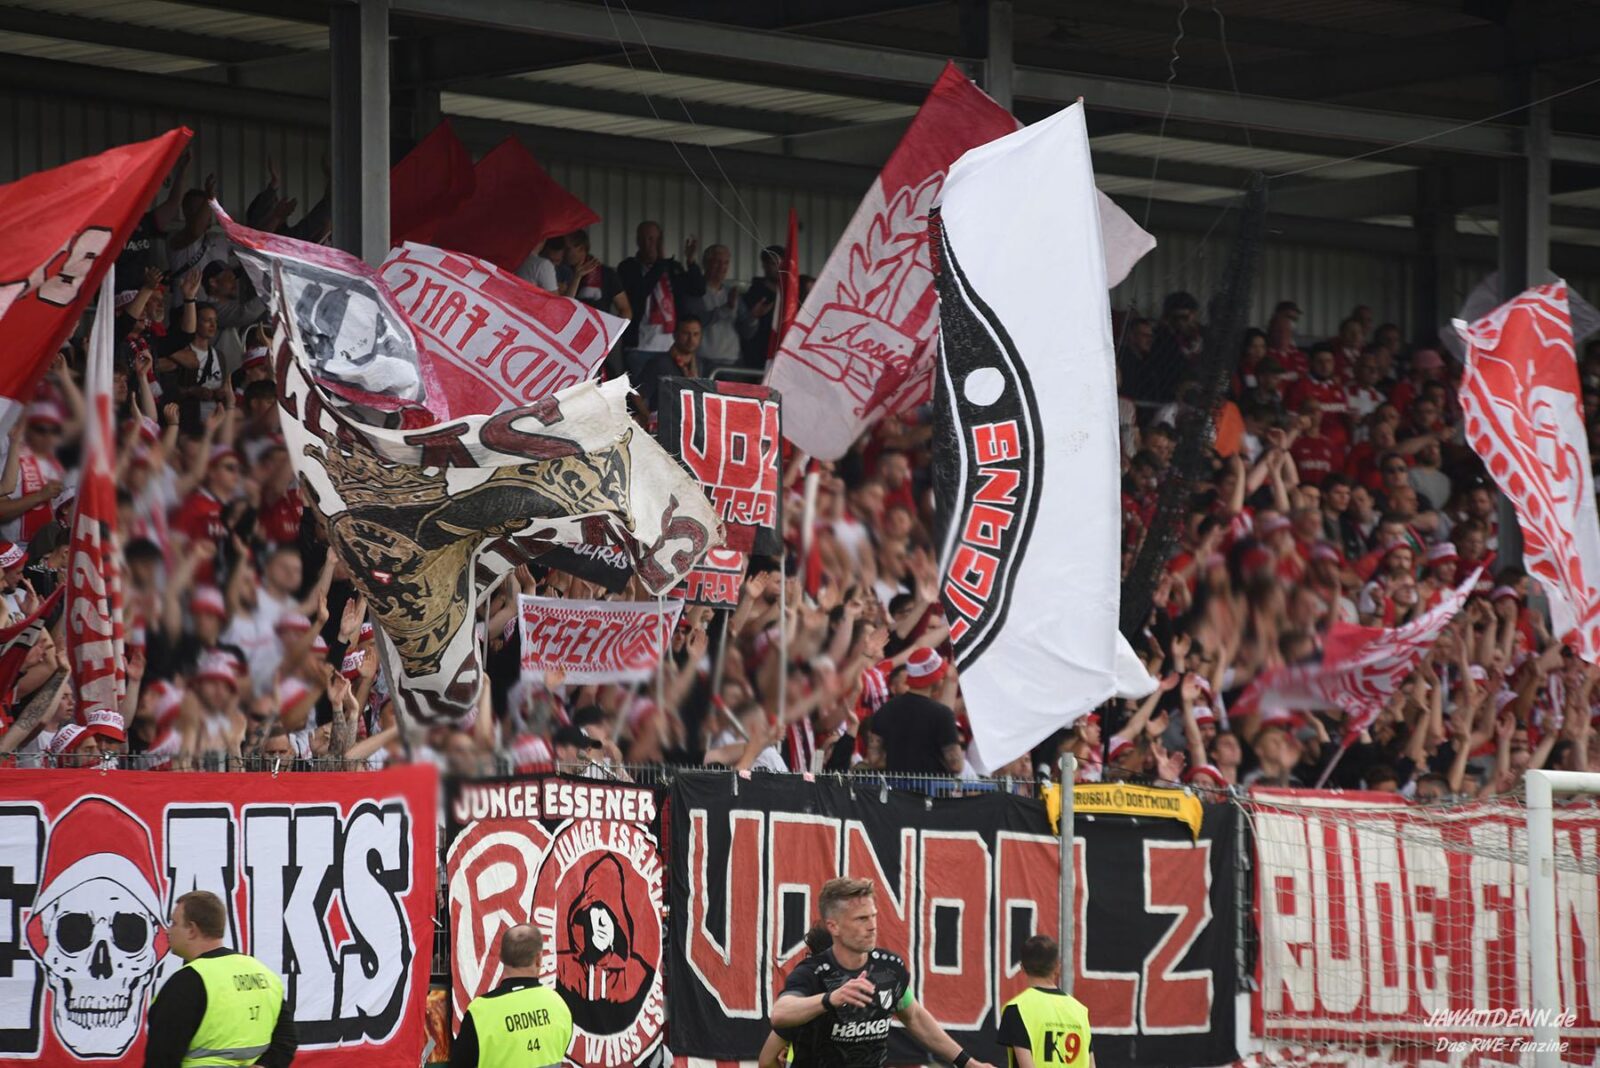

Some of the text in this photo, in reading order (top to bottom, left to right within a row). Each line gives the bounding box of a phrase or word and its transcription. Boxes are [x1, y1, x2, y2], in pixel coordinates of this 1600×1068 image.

[455, 783, 656, 821] JUNGE ESSENER
[1074, 791, 1181, 812] RUSSIA DORTMUND
[553, 820, 605, 873] JUNGE
[232, 972, 271, 991] ORDNER
[248, 1005, 261, 1021] 17
[504, 1008, 551, 1034] ORDNER
[831, 1017, 892, 1038] Häcker
[526, 1038, 541, 1053] 44
[1043, 1030, 1082, 1065] K9
